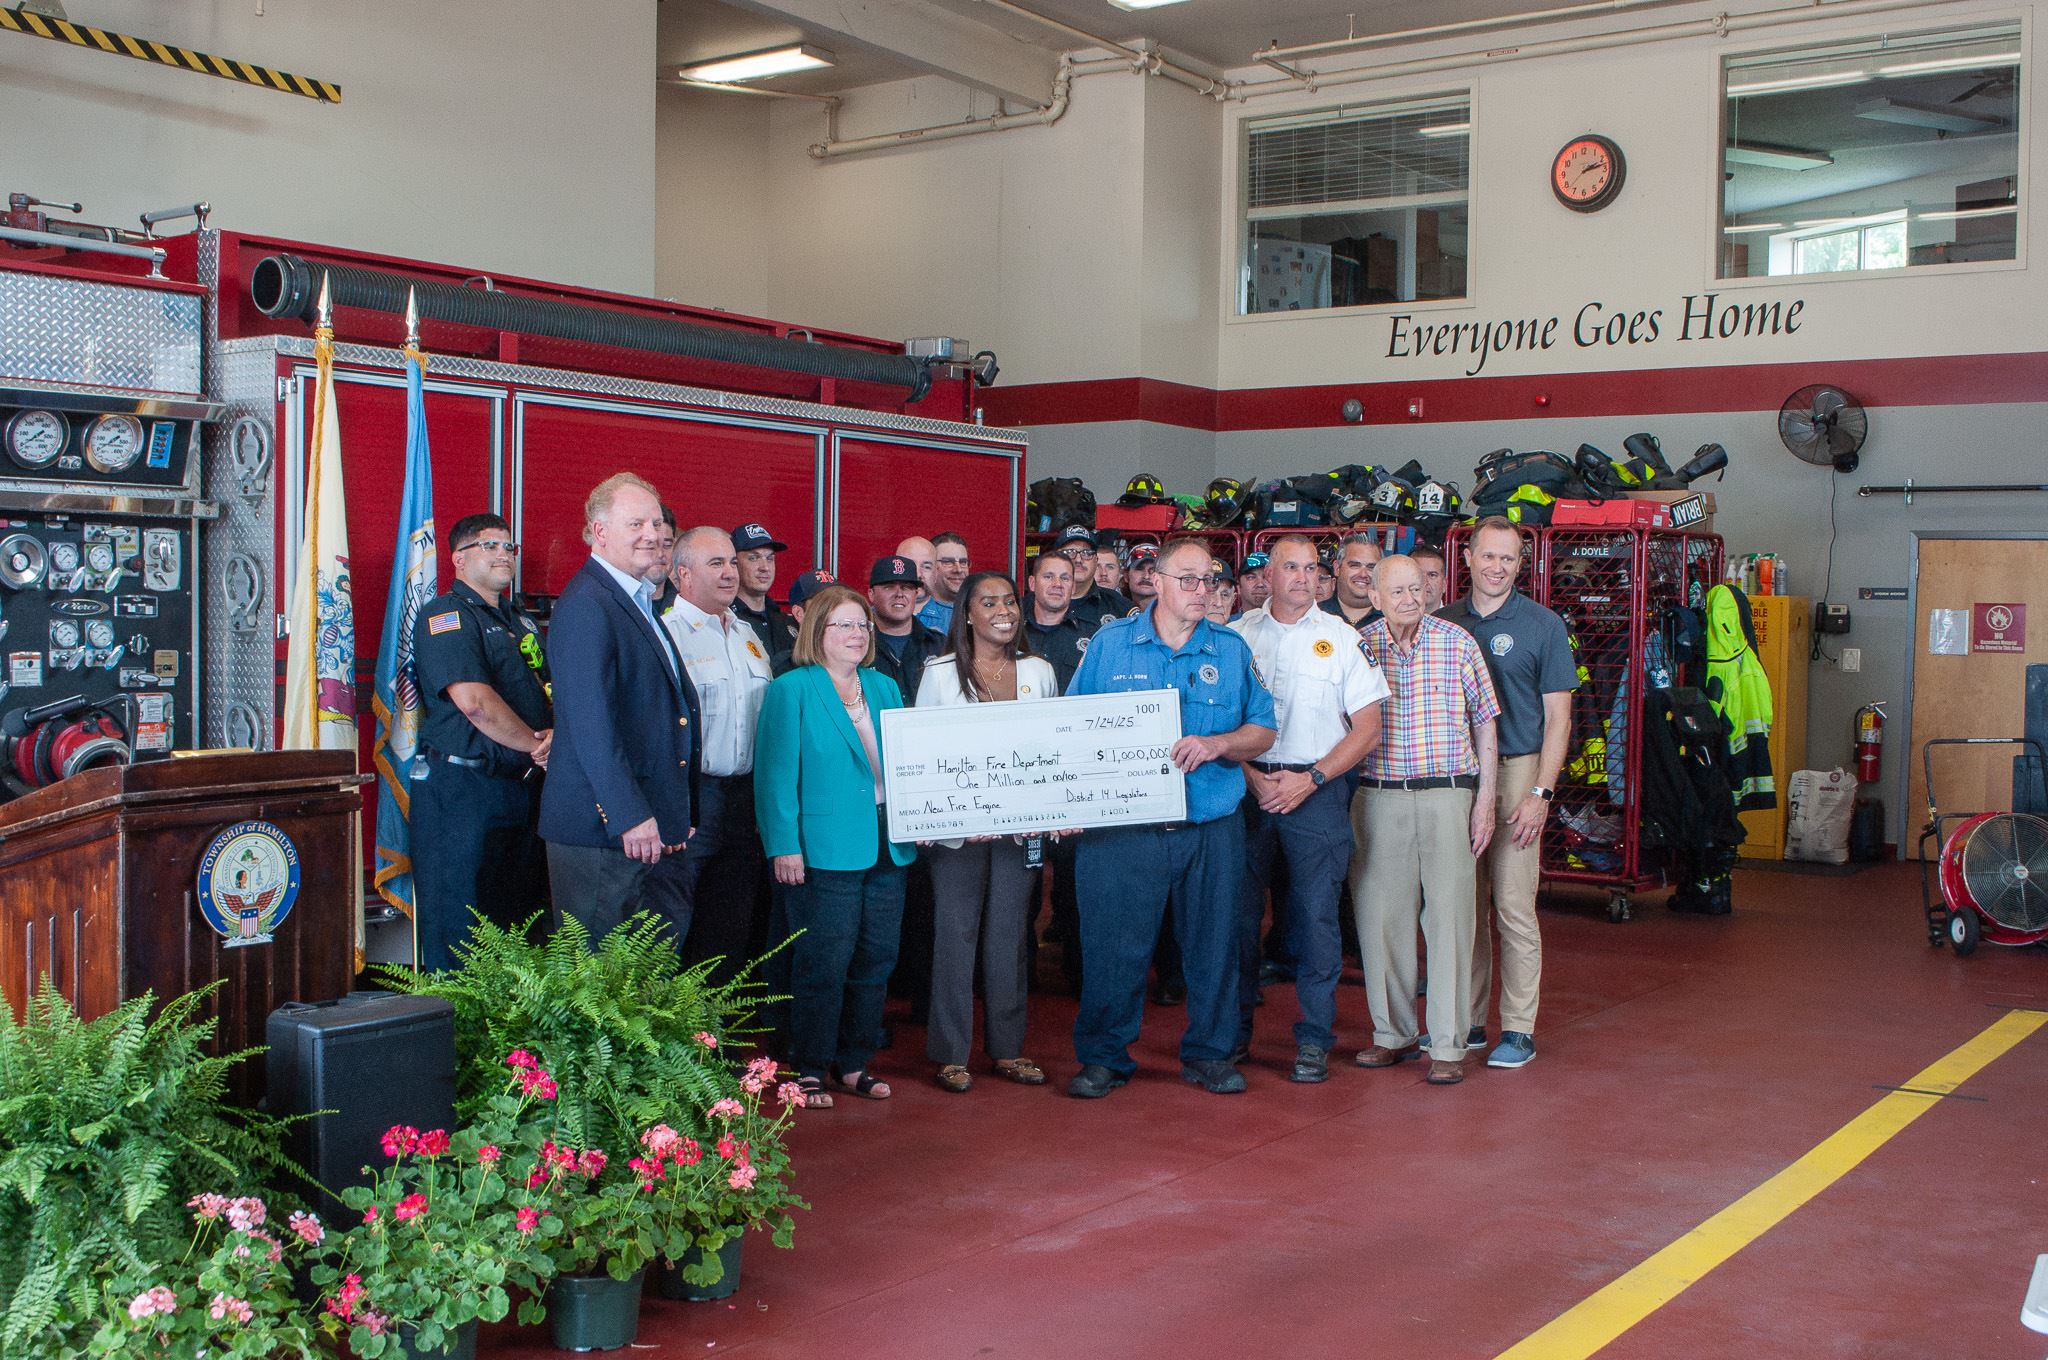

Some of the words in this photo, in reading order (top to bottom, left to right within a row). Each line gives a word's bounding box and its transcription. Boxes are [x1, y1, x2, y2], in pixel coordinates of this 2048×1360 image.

[1572, 151, 1577, 160] 11
[1581, 147, 1587, 155] 12
[1593, 149, 1597, 157] 1
[1600, 155, 1605, 163] 2
[1564, 160, 1571, 168] 10
[1603, 165, 1608, 173] 3
[1561, 171, 1566, 179] 9
[1599, 176, 1604, 184] 4
[1564, 181, 1569, 189] 8
[1592, 184, 1597, 192] 5
[1581, 189, 1587, 197] 6
[1385, 314, 1557, 376] Everyone
[1574, 301, 1663, 348] Goes
[1677, 293, 1805, 341] Home
[1379, 490, 1388, 503] 3
[1421, 493, 1440, 505] 14
[1672, 498, 1702, 524] BRIAN
[1572, 548, 1580, 556] J.
[1582, 547, 1609, 556] DOYLE
[892, 559, 905, 574] B
[1994, 632, 2004, 640] NO
[1135, 703, 1161, 714] 1001
[1085, 716, 1135, 730] 7/24/25
[1097, 750, 1104, 761] $
[937, 757, 977, 774] Hamilton
[986, 756, 1006, 770] Fire
[1012, 750, 1062, 772] Department
[1127, 769, 1158, 777] DOLLARS
[956, 770, 979, 789] One
[987, 772, 1025, 788] Million
[1033, 776, 1046, 785] and
[1066, 788, 1094, 803] District
[1101, 788, 1110, 799] 14
[923, 800, 943, 814] New
[947, 796, 967, 811] Fire
[973, 796, 1001, 814] Engine
[202, 825, 245, 876] TOWNSHIP
[246, 823, 256, 832] of
[257, 823, 297, 866] HAMILTON
